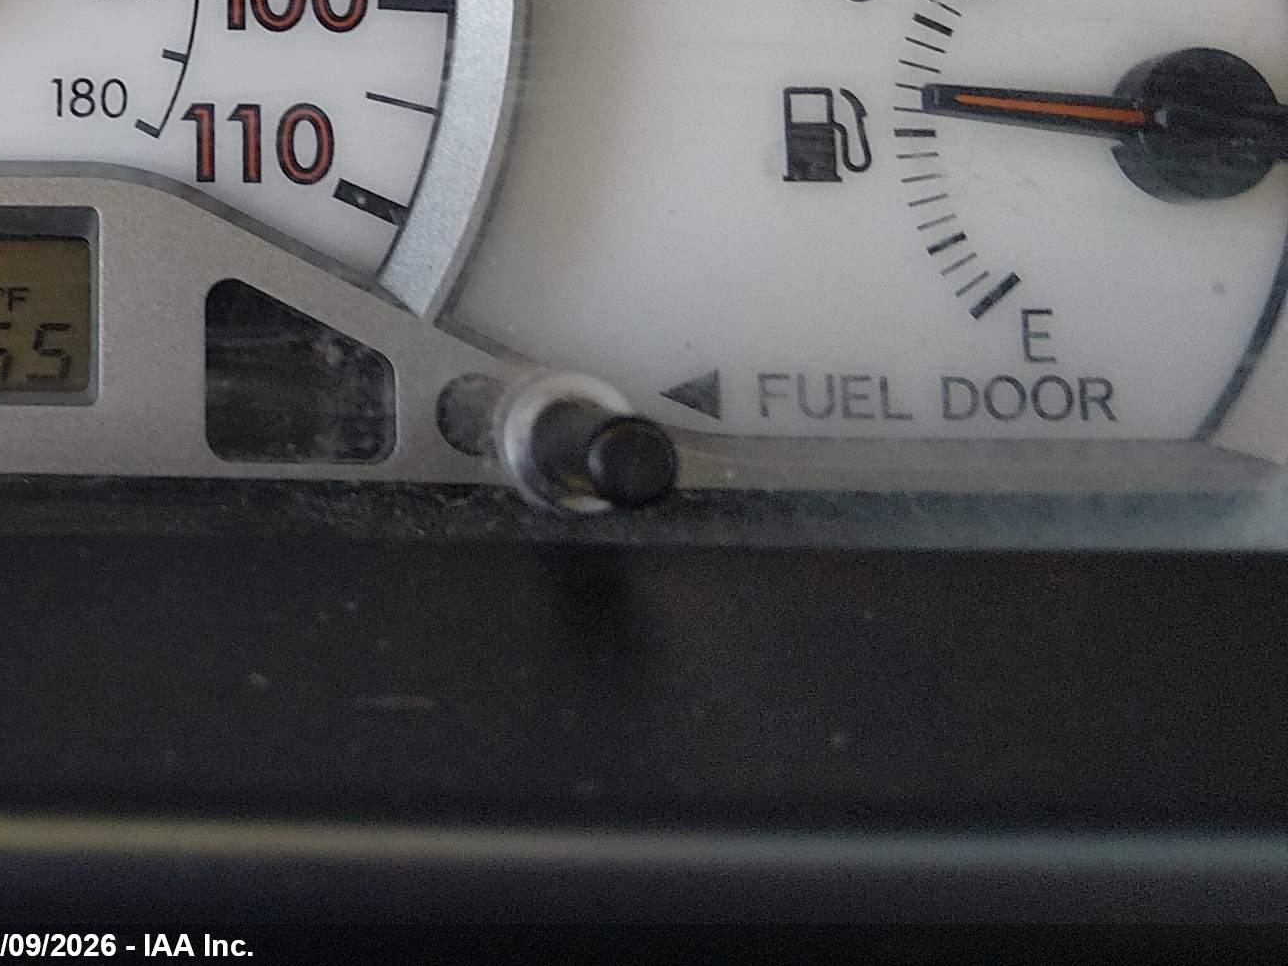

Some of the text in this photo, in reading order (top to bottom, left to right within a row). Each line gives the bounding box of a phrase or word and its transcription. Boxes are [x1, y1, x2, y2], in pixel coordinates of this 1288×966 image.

[50, 78, 128, 119] 180
[181, 103, 336, 185] 110
[1021, 309, 1058, 365] E
[756, 372, 1117, 424] FUEL DOOR
